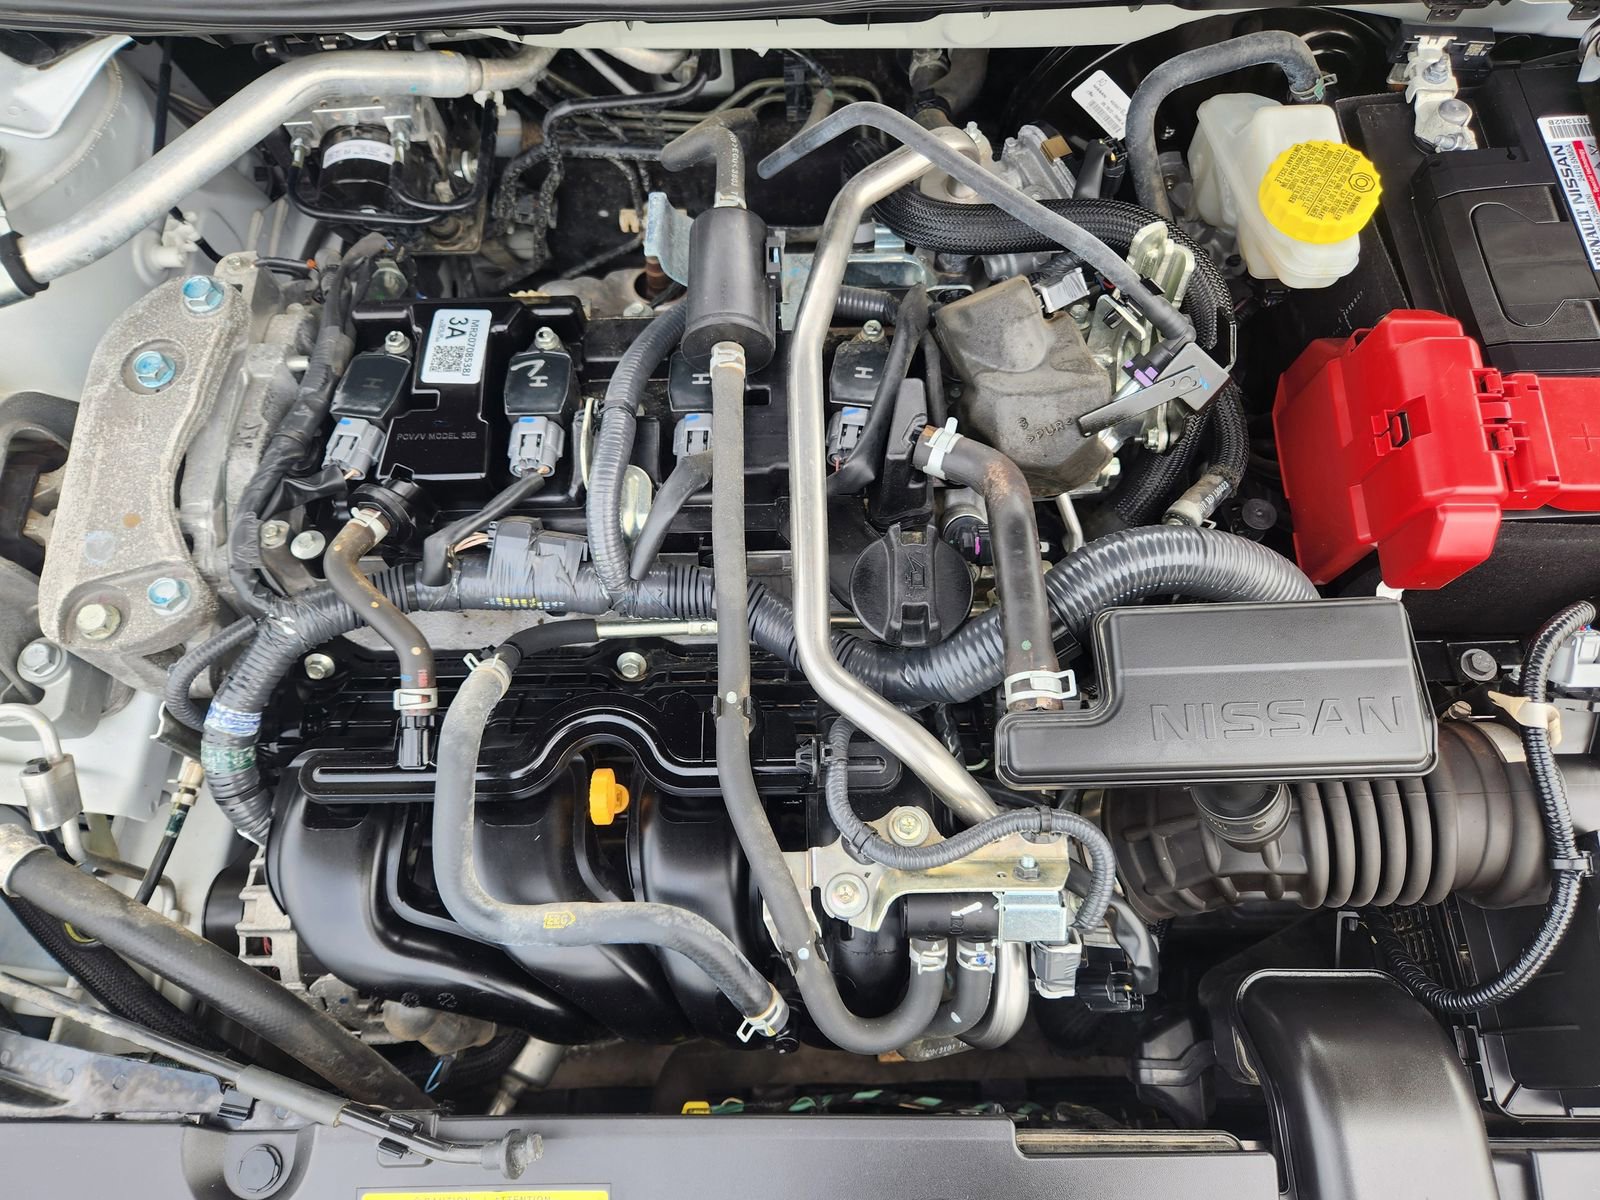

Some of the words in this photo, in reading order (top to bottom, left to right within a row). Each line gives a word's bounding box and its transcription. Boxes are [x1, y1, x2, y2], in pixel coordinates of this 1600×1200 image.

[1552, 144, 1586, 206] NISSAN
[445, 317, 469, 339] 3A
[462, 319, 480, 376] MR20708538J
[428, 432, 459, 440] MODEL
[1151, 696, 1402, 741] NISSAN
